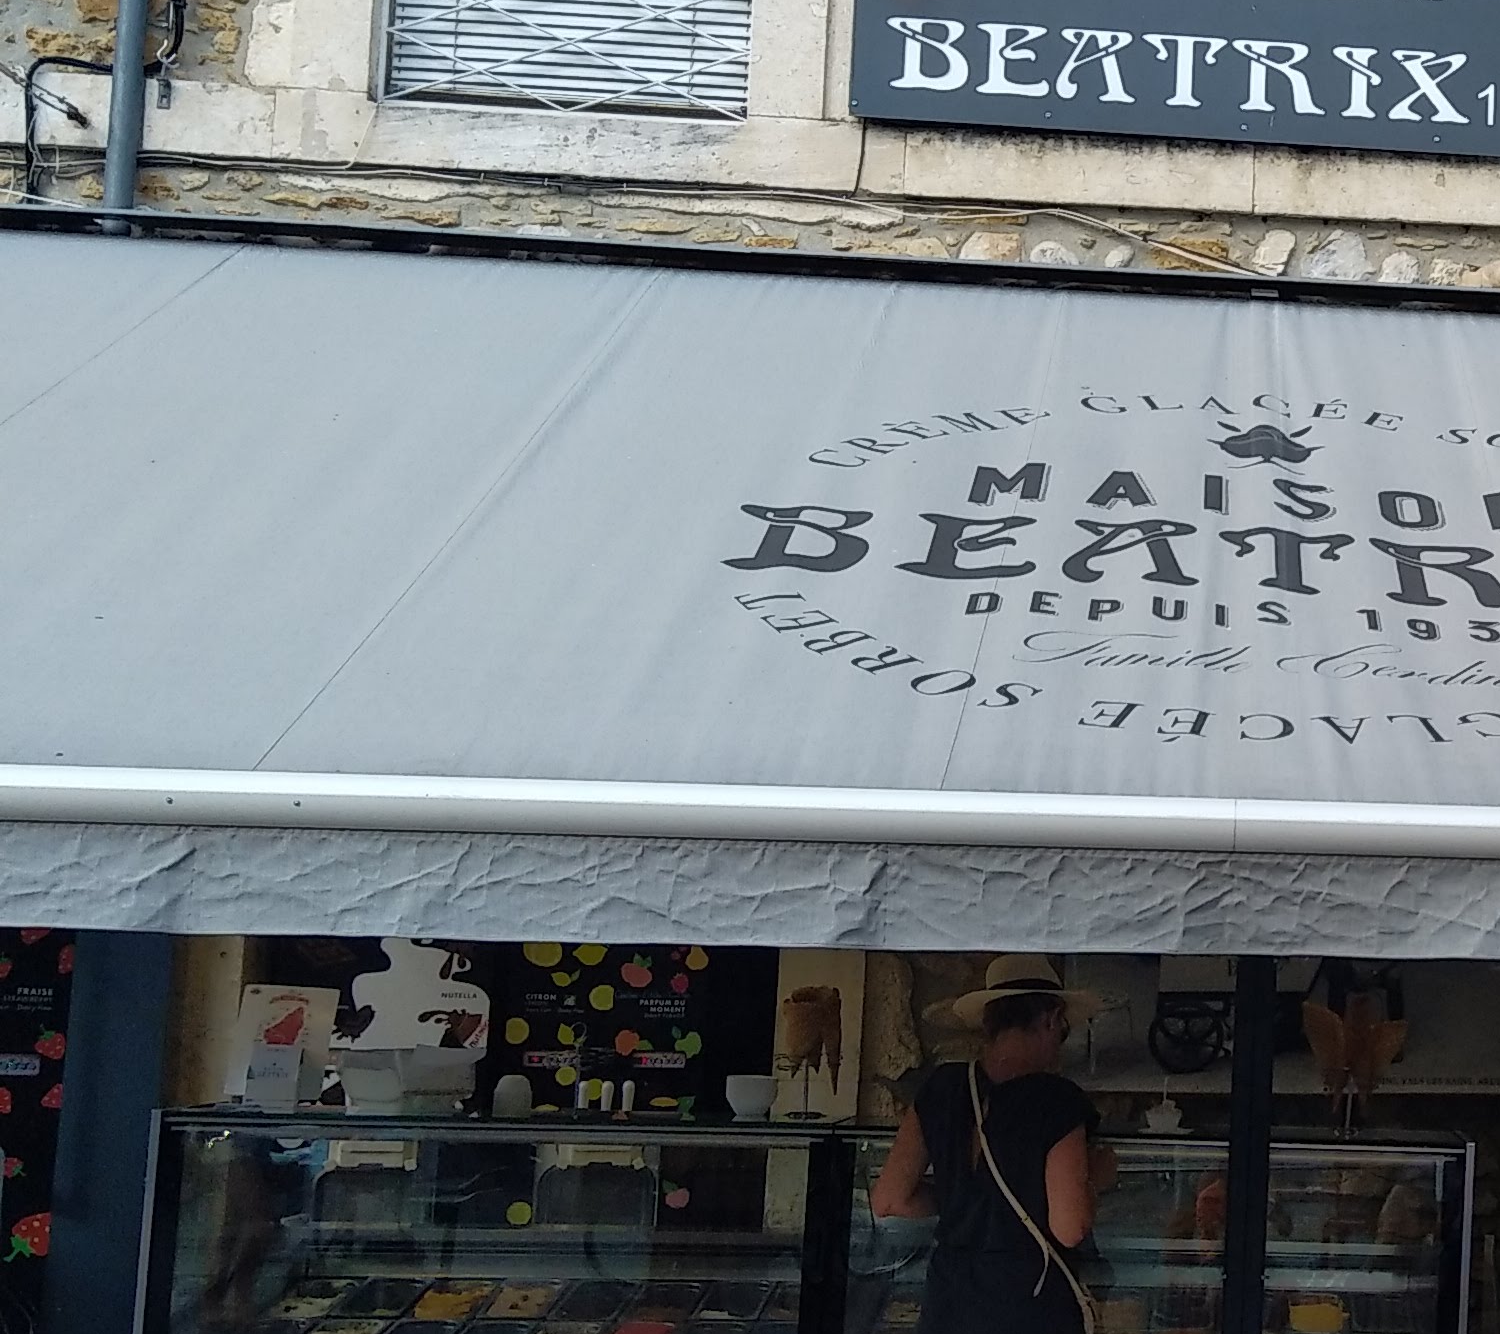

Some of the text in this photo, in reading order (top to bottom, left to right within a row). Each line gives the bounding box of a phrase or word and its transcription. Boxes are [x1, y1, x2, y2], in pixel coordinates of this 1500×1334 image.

[886, 15, 1470, 126] BEATRIX
[808, 406, 1051, 468] CRÈME
[1081, 394, 1404, 432] GLACÉE
[965, 590, 1292, 627] DEPUIS
[733, 592, 1044, 708] SORBET
[17, 987, 53, 995] FRAISE
[525, 993, 557, 1001] CITRON
